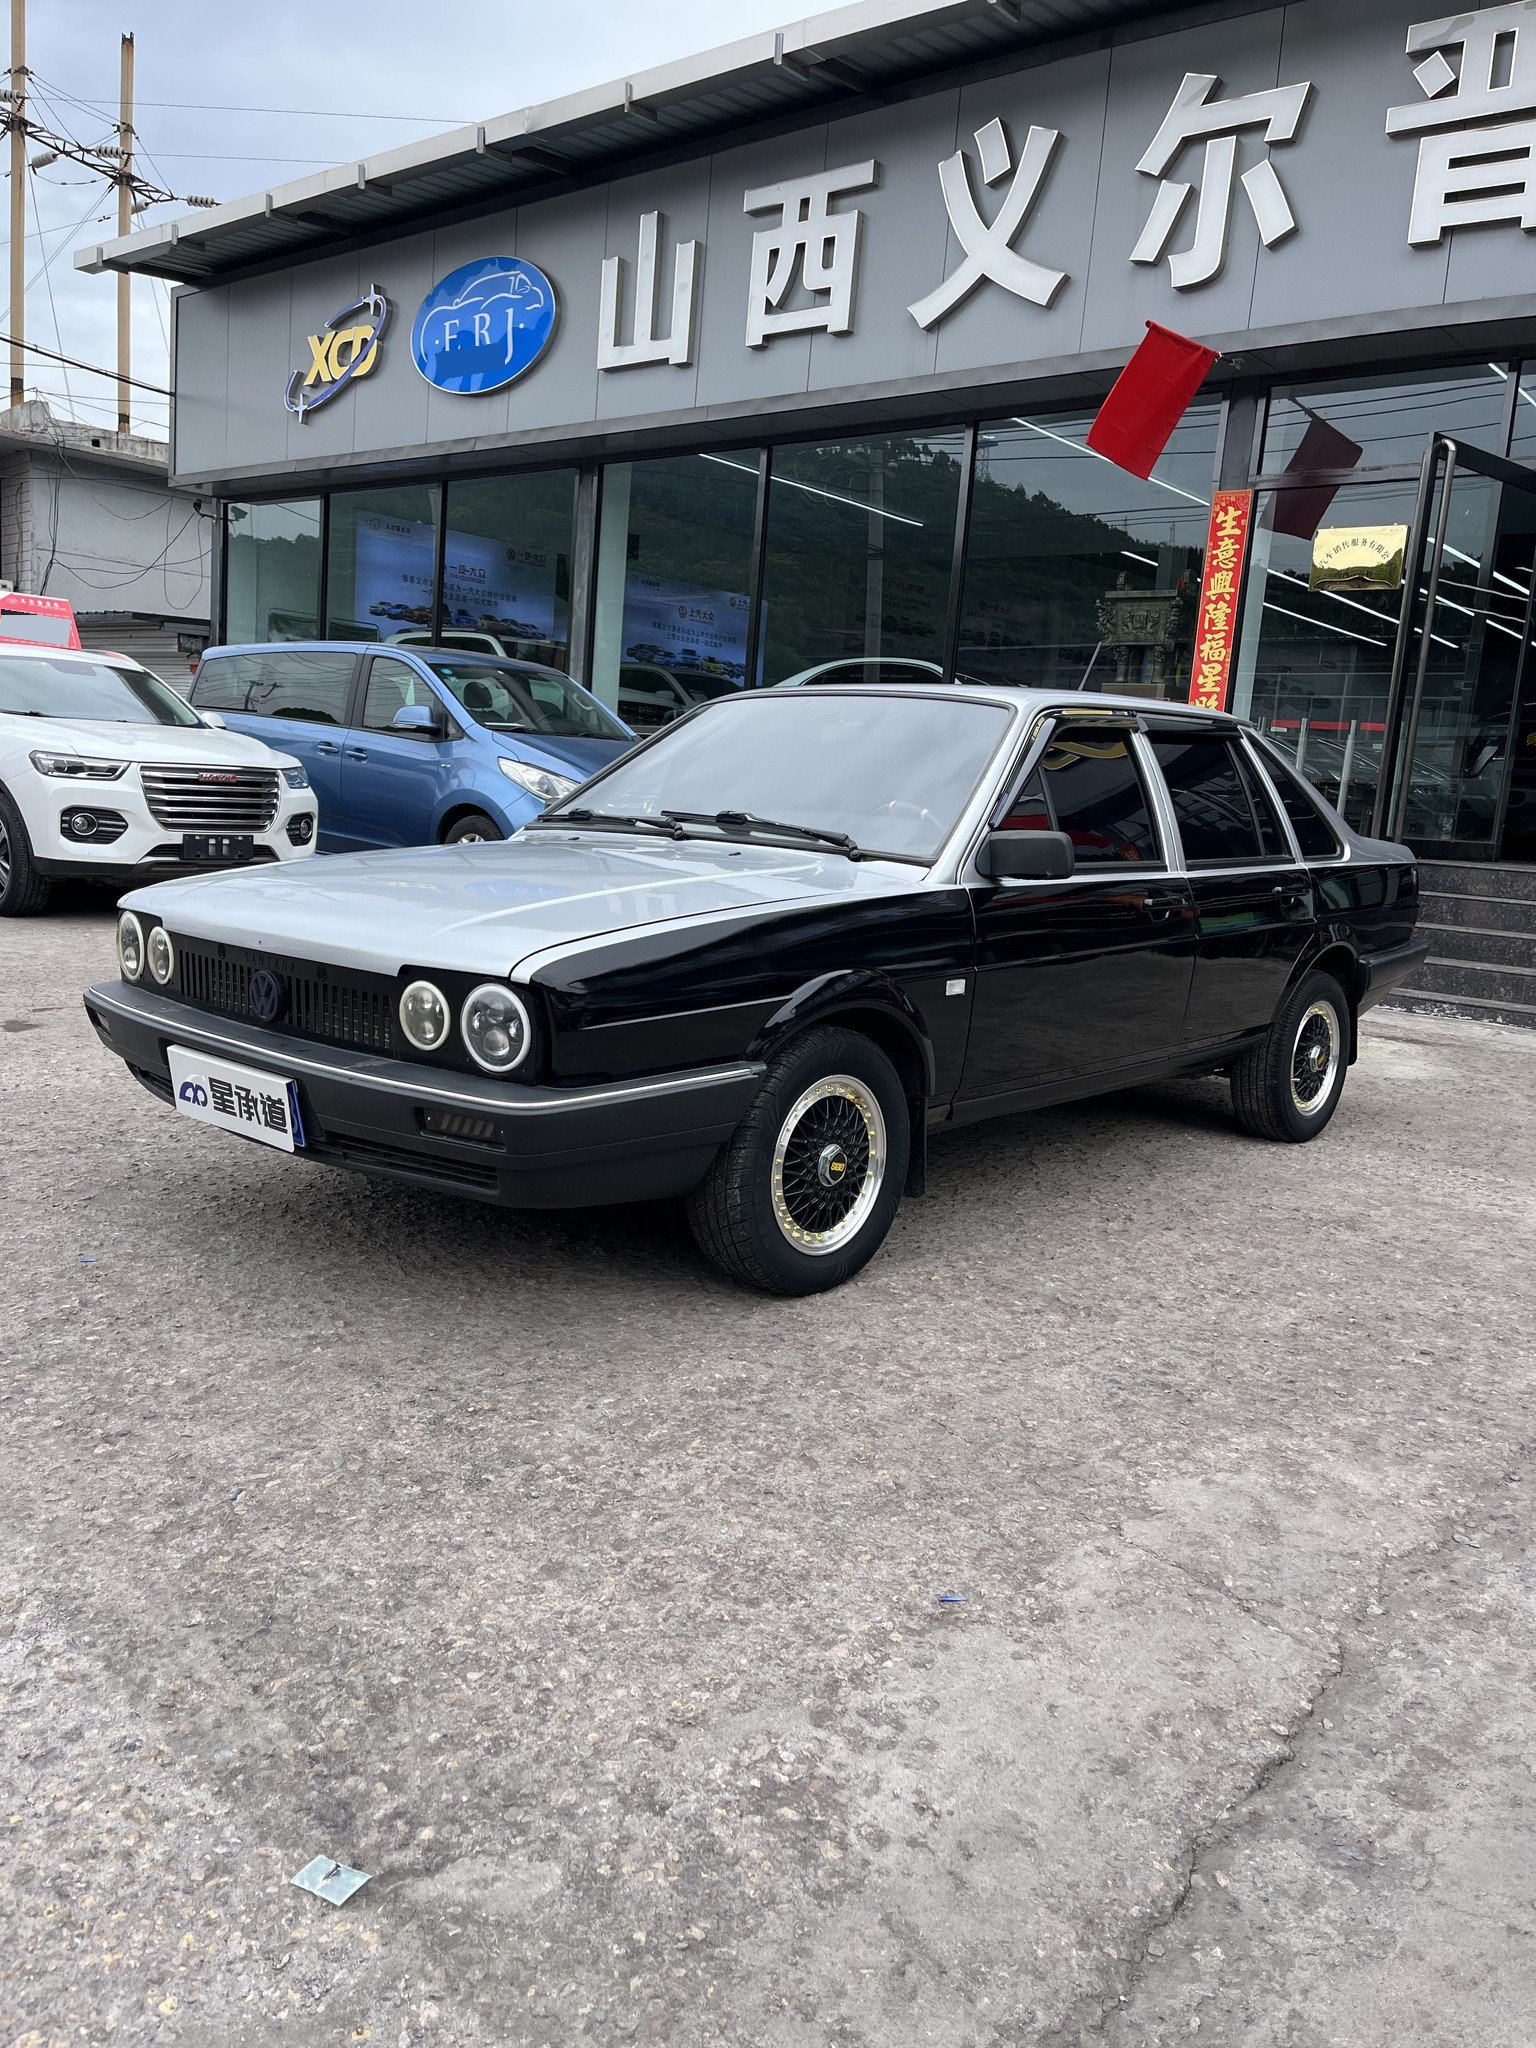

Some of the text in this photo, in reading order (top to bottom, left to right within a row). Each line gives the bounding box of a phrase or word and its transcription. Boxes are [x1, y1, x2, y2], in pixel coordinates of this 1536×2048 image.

[303, 325, 378, 386] XCD
[244, 951, 295, 974] SANTANA
[208, 1076, 288, 1135] 星承道
